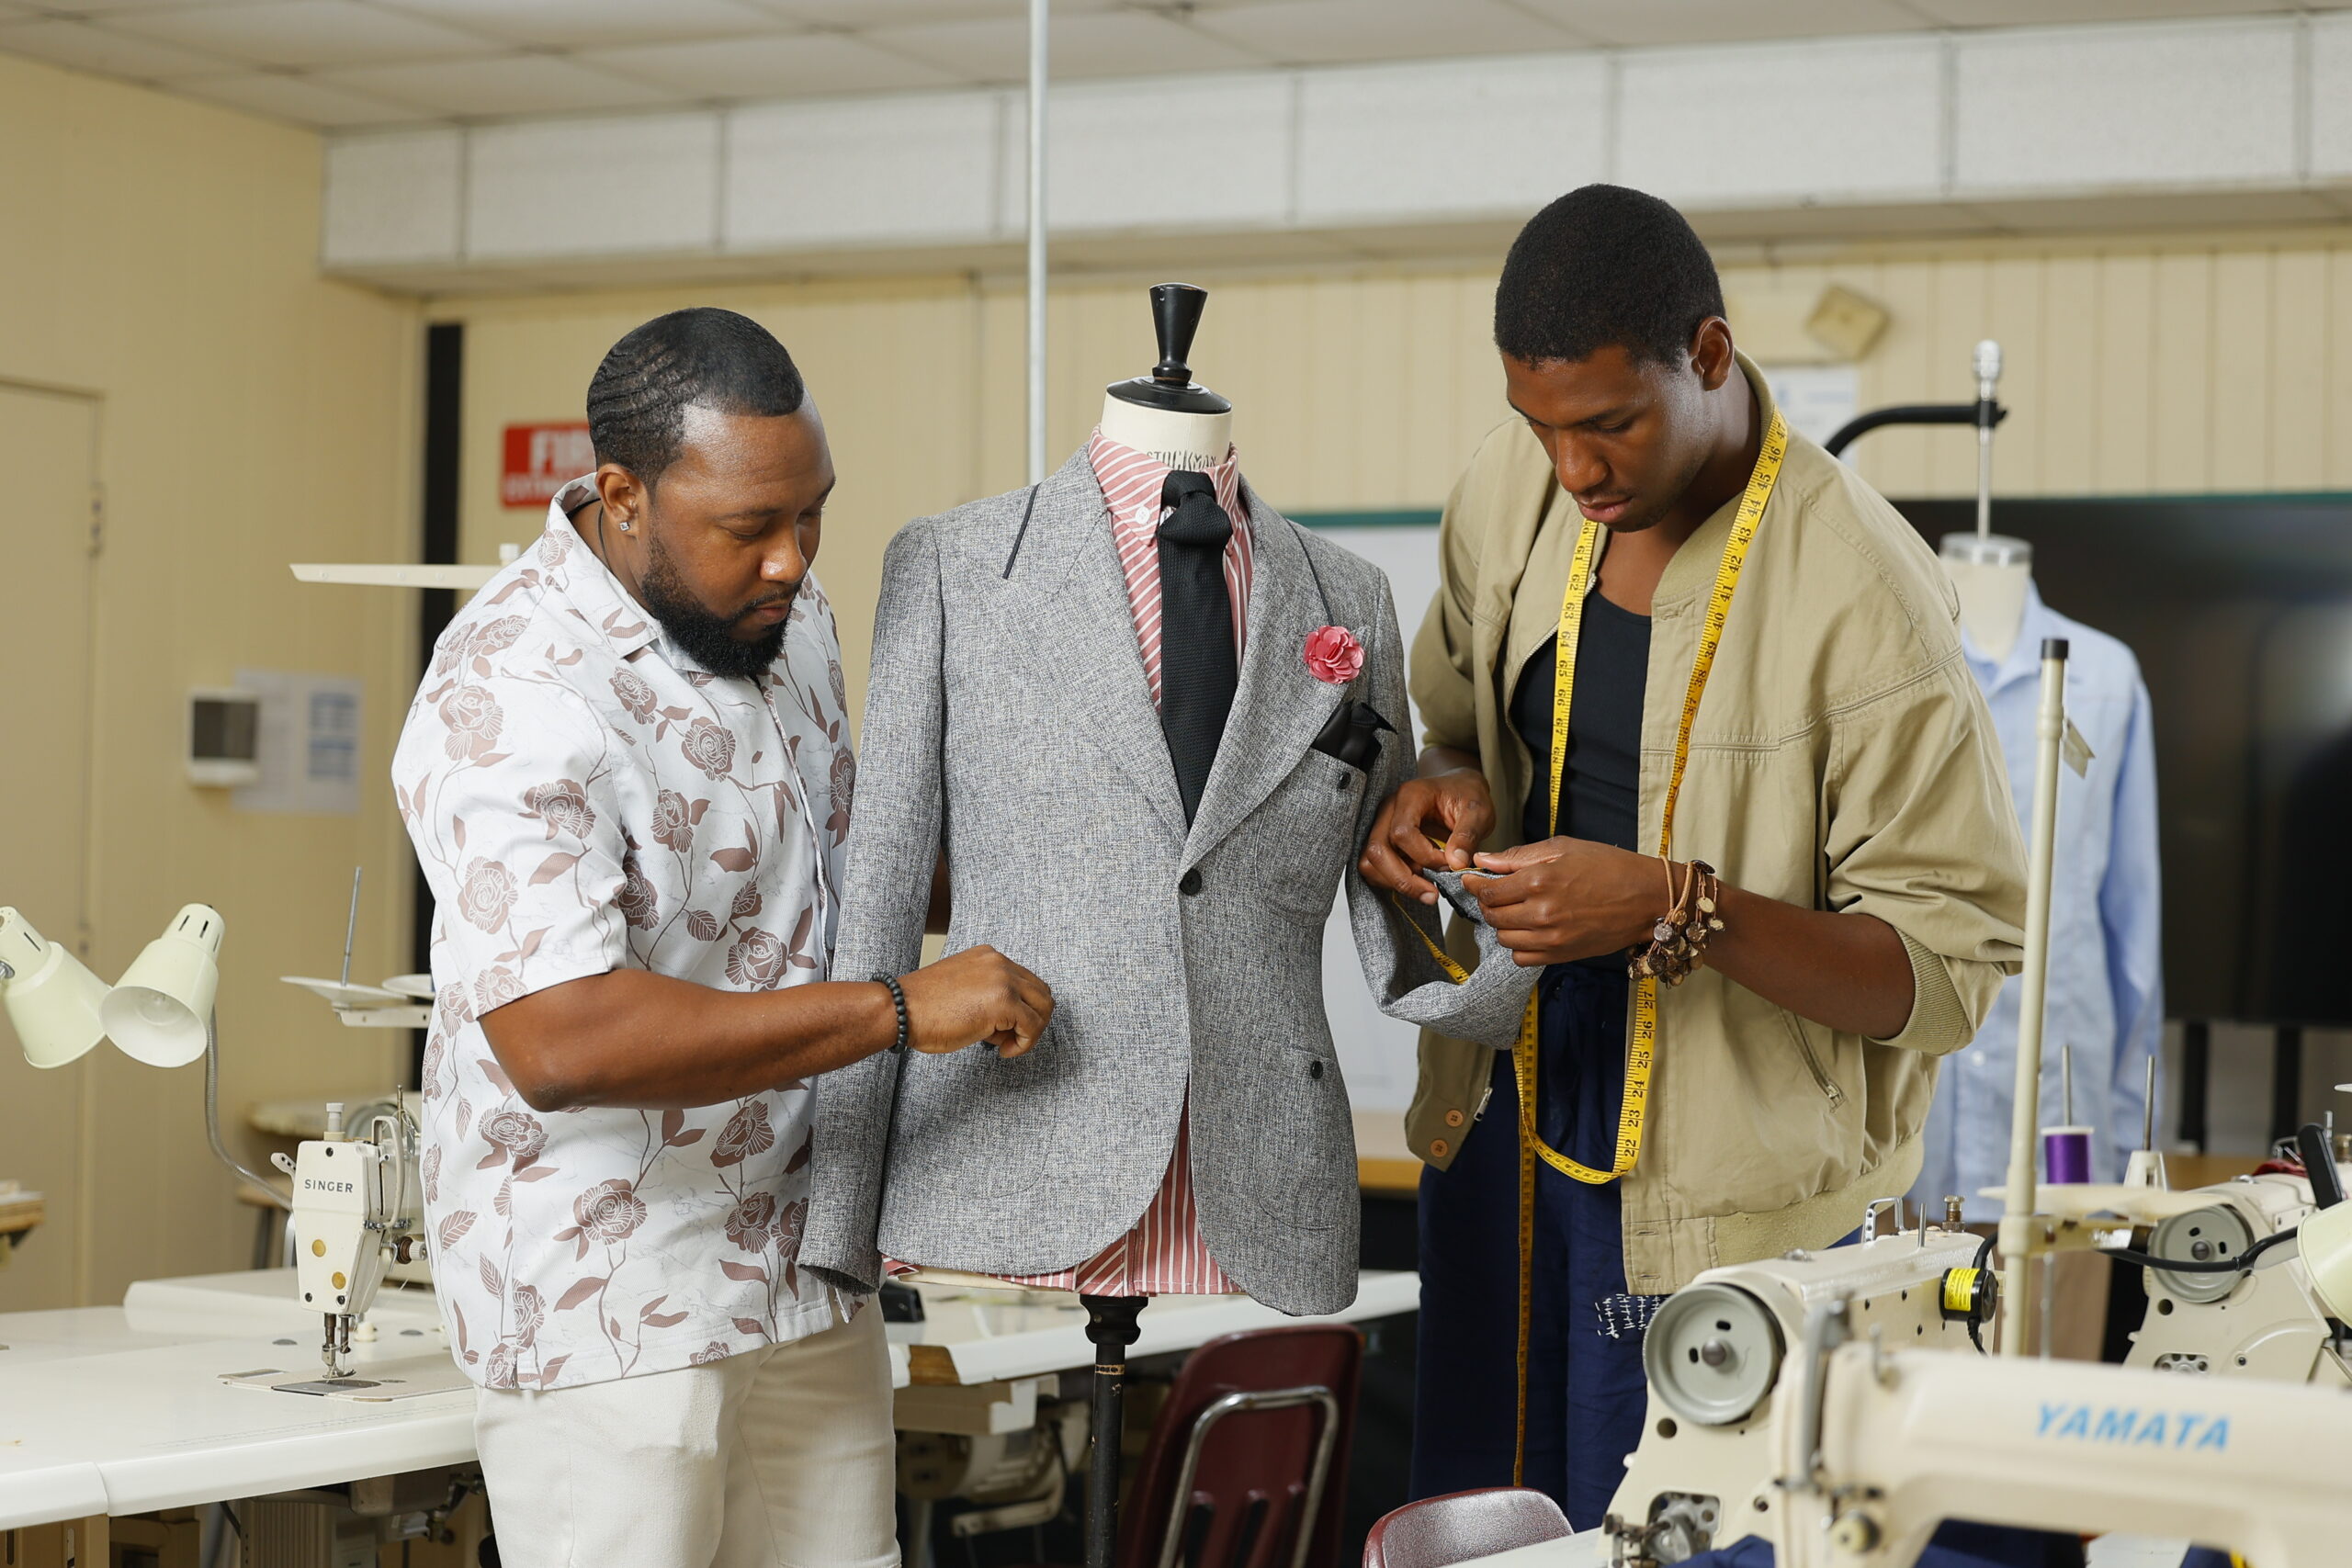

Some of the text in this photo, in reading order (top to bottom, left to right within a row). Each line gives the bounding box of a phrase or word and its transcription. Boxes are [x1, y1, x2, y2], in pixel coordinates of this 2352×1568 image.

[530, 430, 595, 476] FIR
[1575, 546, 1586, 561] 61
[1569, 573, 1580, 591] 62
[1687, 697, 1697, 716] 37
[1694, 669, 1707, 687] 38
[1704, 641, 1717, 660] 39
[1713, 612, 1724, 631] 40
[1720, 585, 1735, 603] 41
[1728, 555, 1743, 574] 42
[1737, 526, 1752, 546] 43
[1747, 499, 1761, 517] 44
[1757, 473, 1771, 491] 45
[1768, 446, 1781, 464] 46
[1564, 602, 1576, 619] 63
[1560, 630, 1571, 648] 64
[1558, 660, 1568, 677] 65
[1556, 688, 1566, 706] 66
[1555, 717, 1564, 735] 67
[1644, 990, 1654, 1010] 27
[1642, 1021, 1653, 1040] 26
[1637, 1051, 1650, 1069] 25
[1632, 1079, 1645, 1099] 24
[1627, 1109, 1641, 1128] 23
[1623, 1139, 1637, 1157] 22
[304, 1179, 354, 1193] SINGER
[2037, 1402, 2230, 1451] YAMATA
